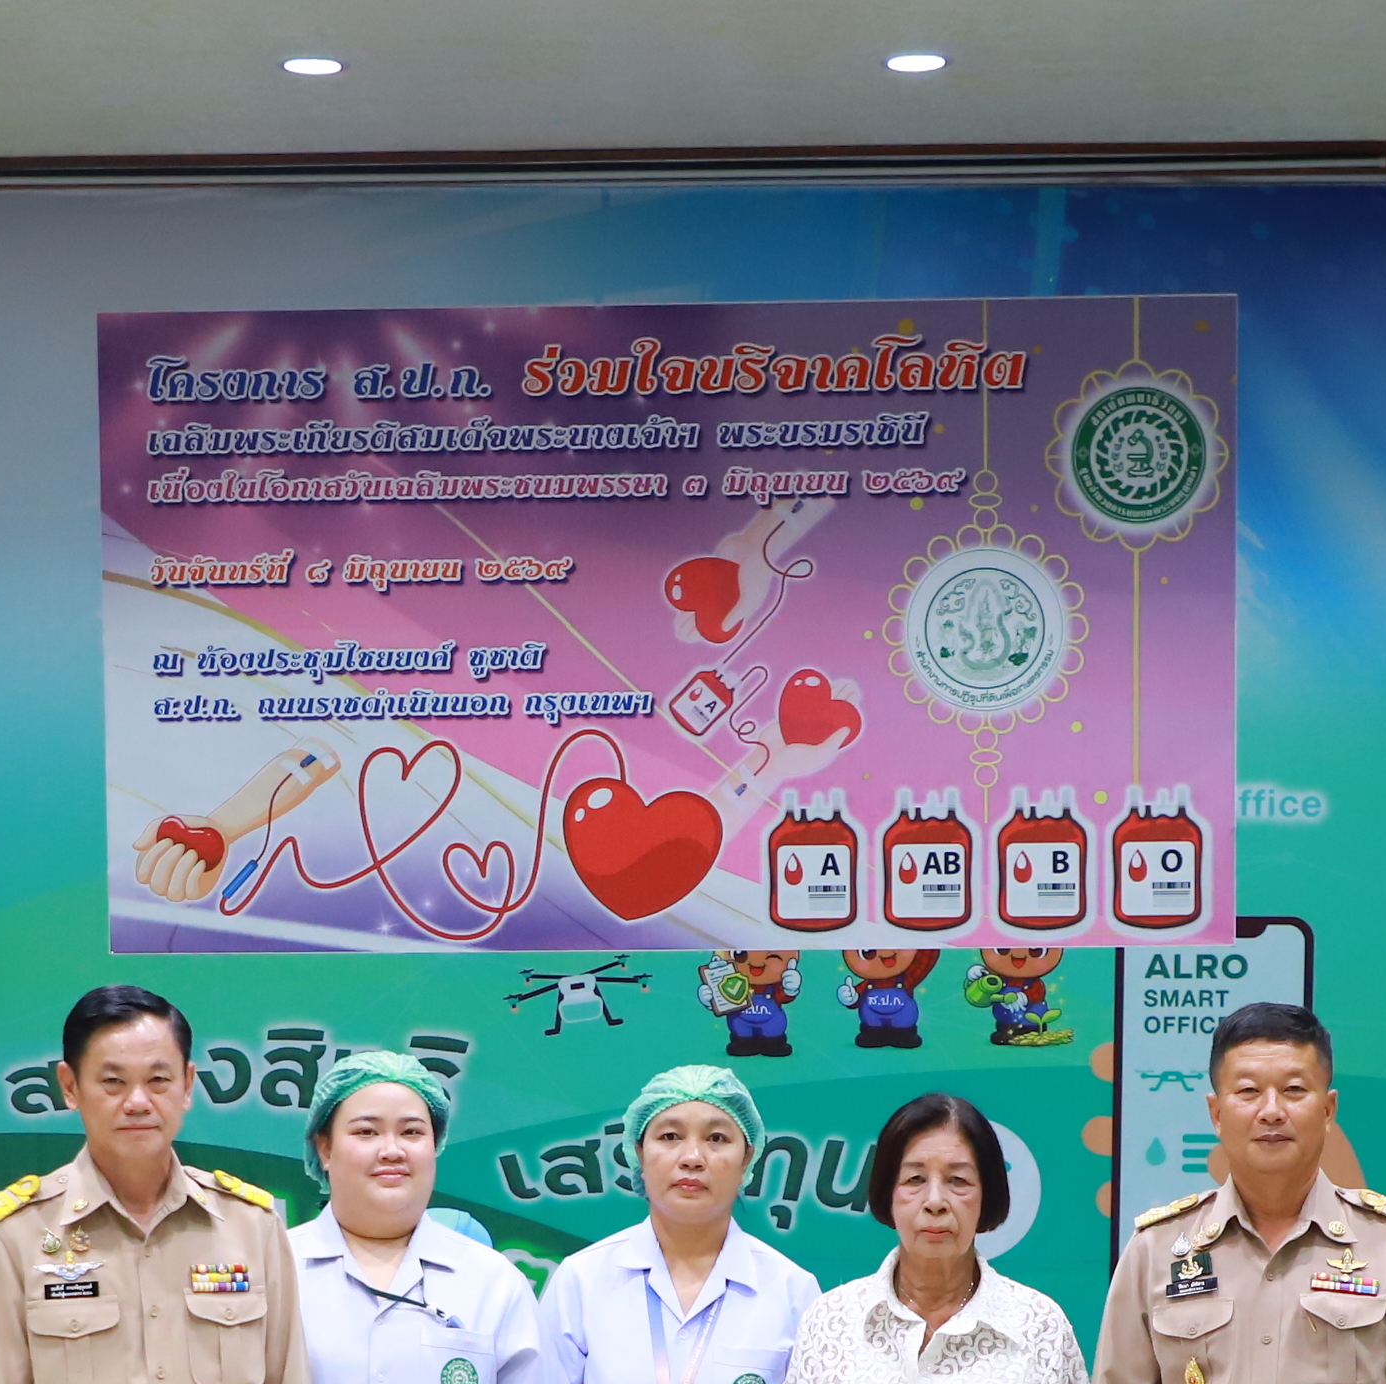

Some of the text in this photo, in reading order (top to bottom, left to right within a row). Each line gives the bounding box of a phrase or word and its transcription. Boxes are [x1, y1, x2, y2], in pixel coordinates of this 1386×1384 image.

[146, 335, 1028, 401] โครงการ ส.ป.ก. ร่วมใจบริจาคโลหิต
[146, 410, 930, 456] เฉลิมพระเกียรติสมเด็จพระนางเจ้าฯ พระบรมราชินี
[146, 466, 967, 506] เนื่องในโอกาสวันเฉลิมพระชนมพรรษา ๓ มิถุนายน ๒๕๖๙
[149, 549, 574, 593] วันจันทร์ที่ ๘ มิถุนายน ๒๕๖๙
[152, 640, 550, 683] ณ ห้องประชุมไชยยงค์ ชูชาติ
[153, 687, 657, 725] ส.ป.ก. ถนนราชดำเนินนอก กรุงเทพฯ
[820, 852, 841, 876] A
[922, 851, 962, 876] AB
[1051, 849, 1071, 874] B
[1160, 849, 1184, 873] O
[1144, 953, 1249, 980] ALRO
[1143, 989, 1230, 1008] SMART
